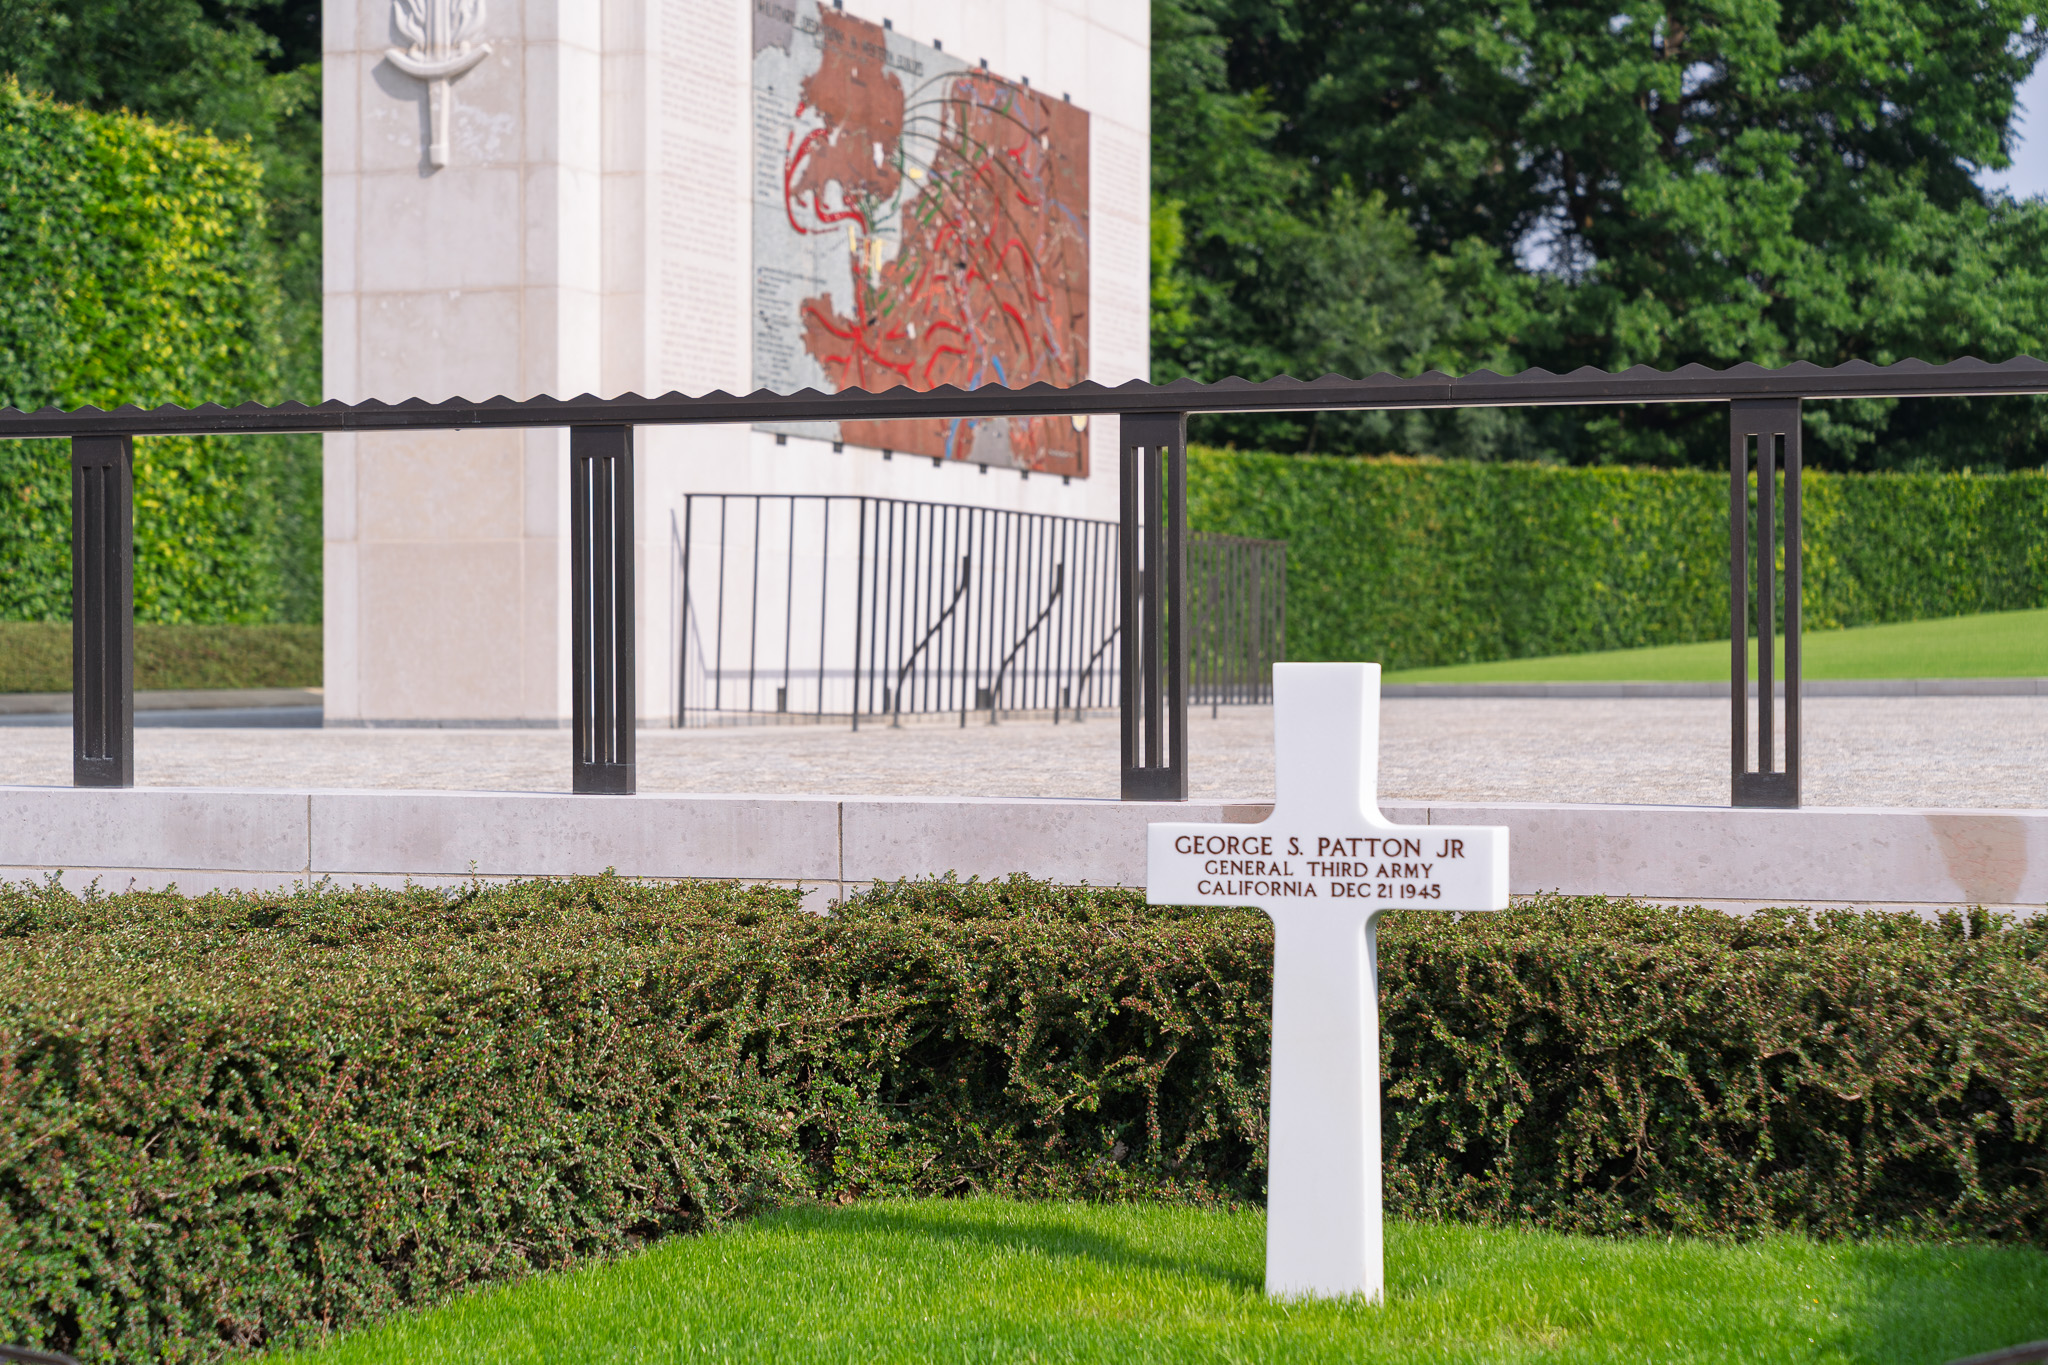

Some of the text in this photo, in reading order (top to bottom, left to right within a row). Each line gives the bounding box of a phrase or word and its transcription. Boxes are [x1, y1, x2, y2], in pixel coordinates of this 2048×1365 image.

[1174, 835, 1465, 859] GEORGE S. PATTON JR
[1204, 859, 1433, 879] GENERAL THIRD ARMY
[1197, 879, 1441, 900] CALIFORNIA DEC 21 1945
